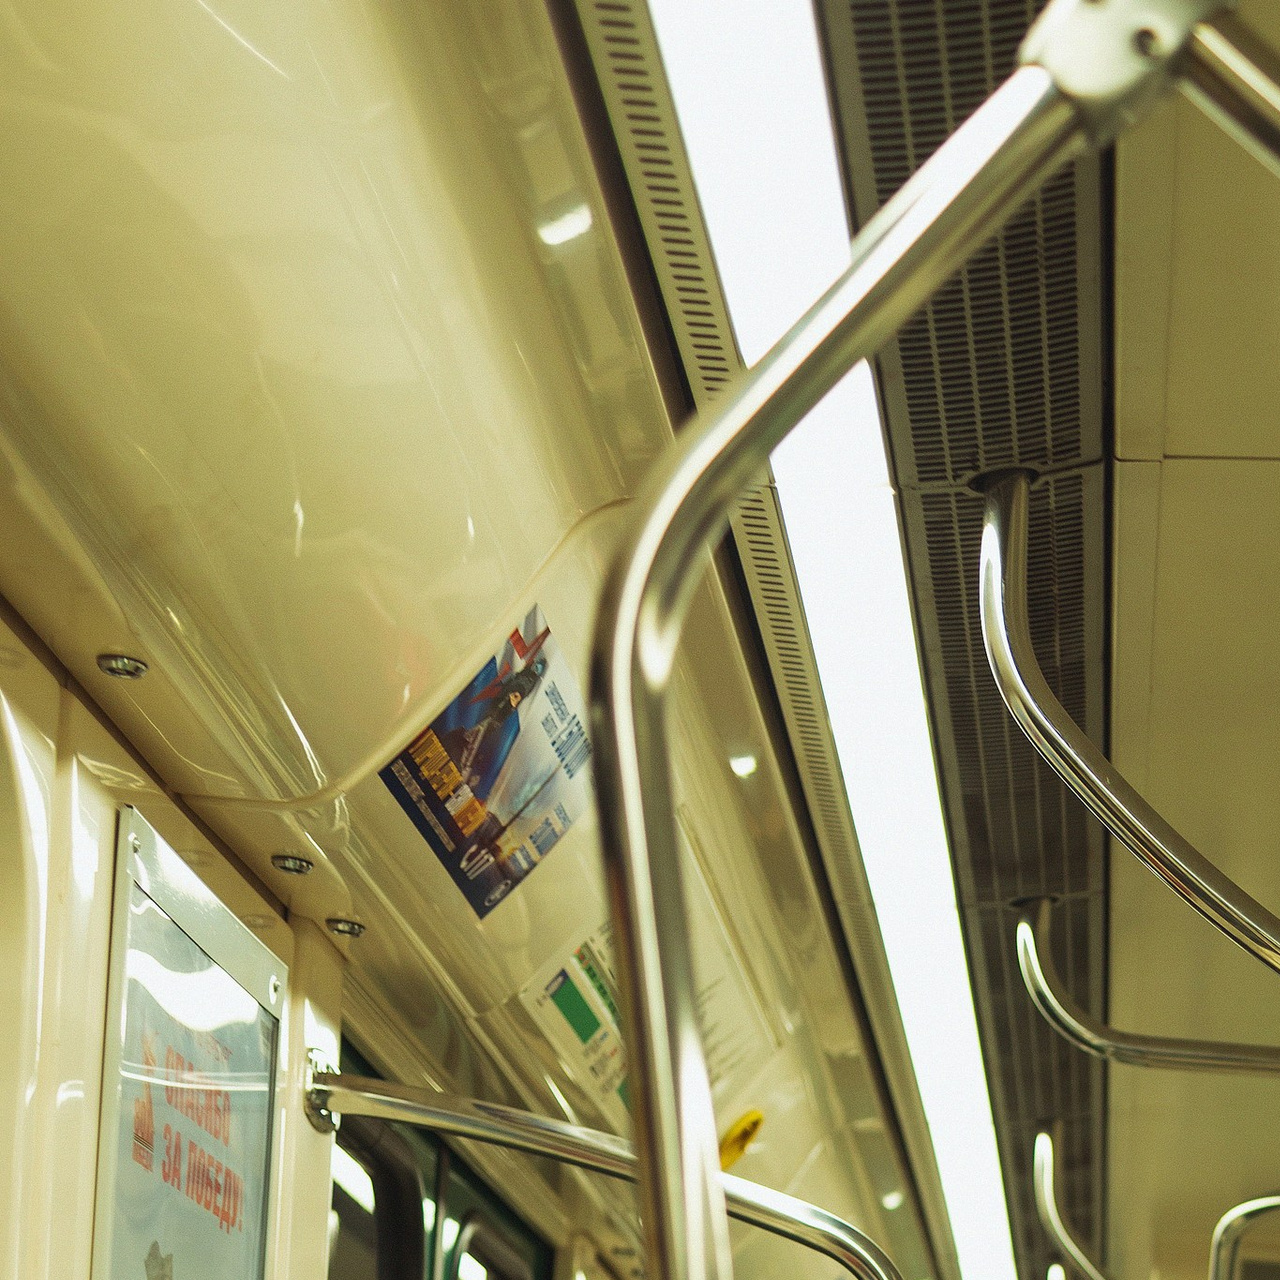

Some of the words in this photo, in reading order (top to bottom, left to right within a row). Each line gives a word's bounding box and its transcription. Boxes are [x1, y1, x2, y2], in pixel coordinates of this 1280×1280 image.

[165, 1044, 231, 1148] СПАСИБО
[162, 1122, 182, 1192] ЗА
[185, 1138, 244, 1235] ПОБЕДУ!
